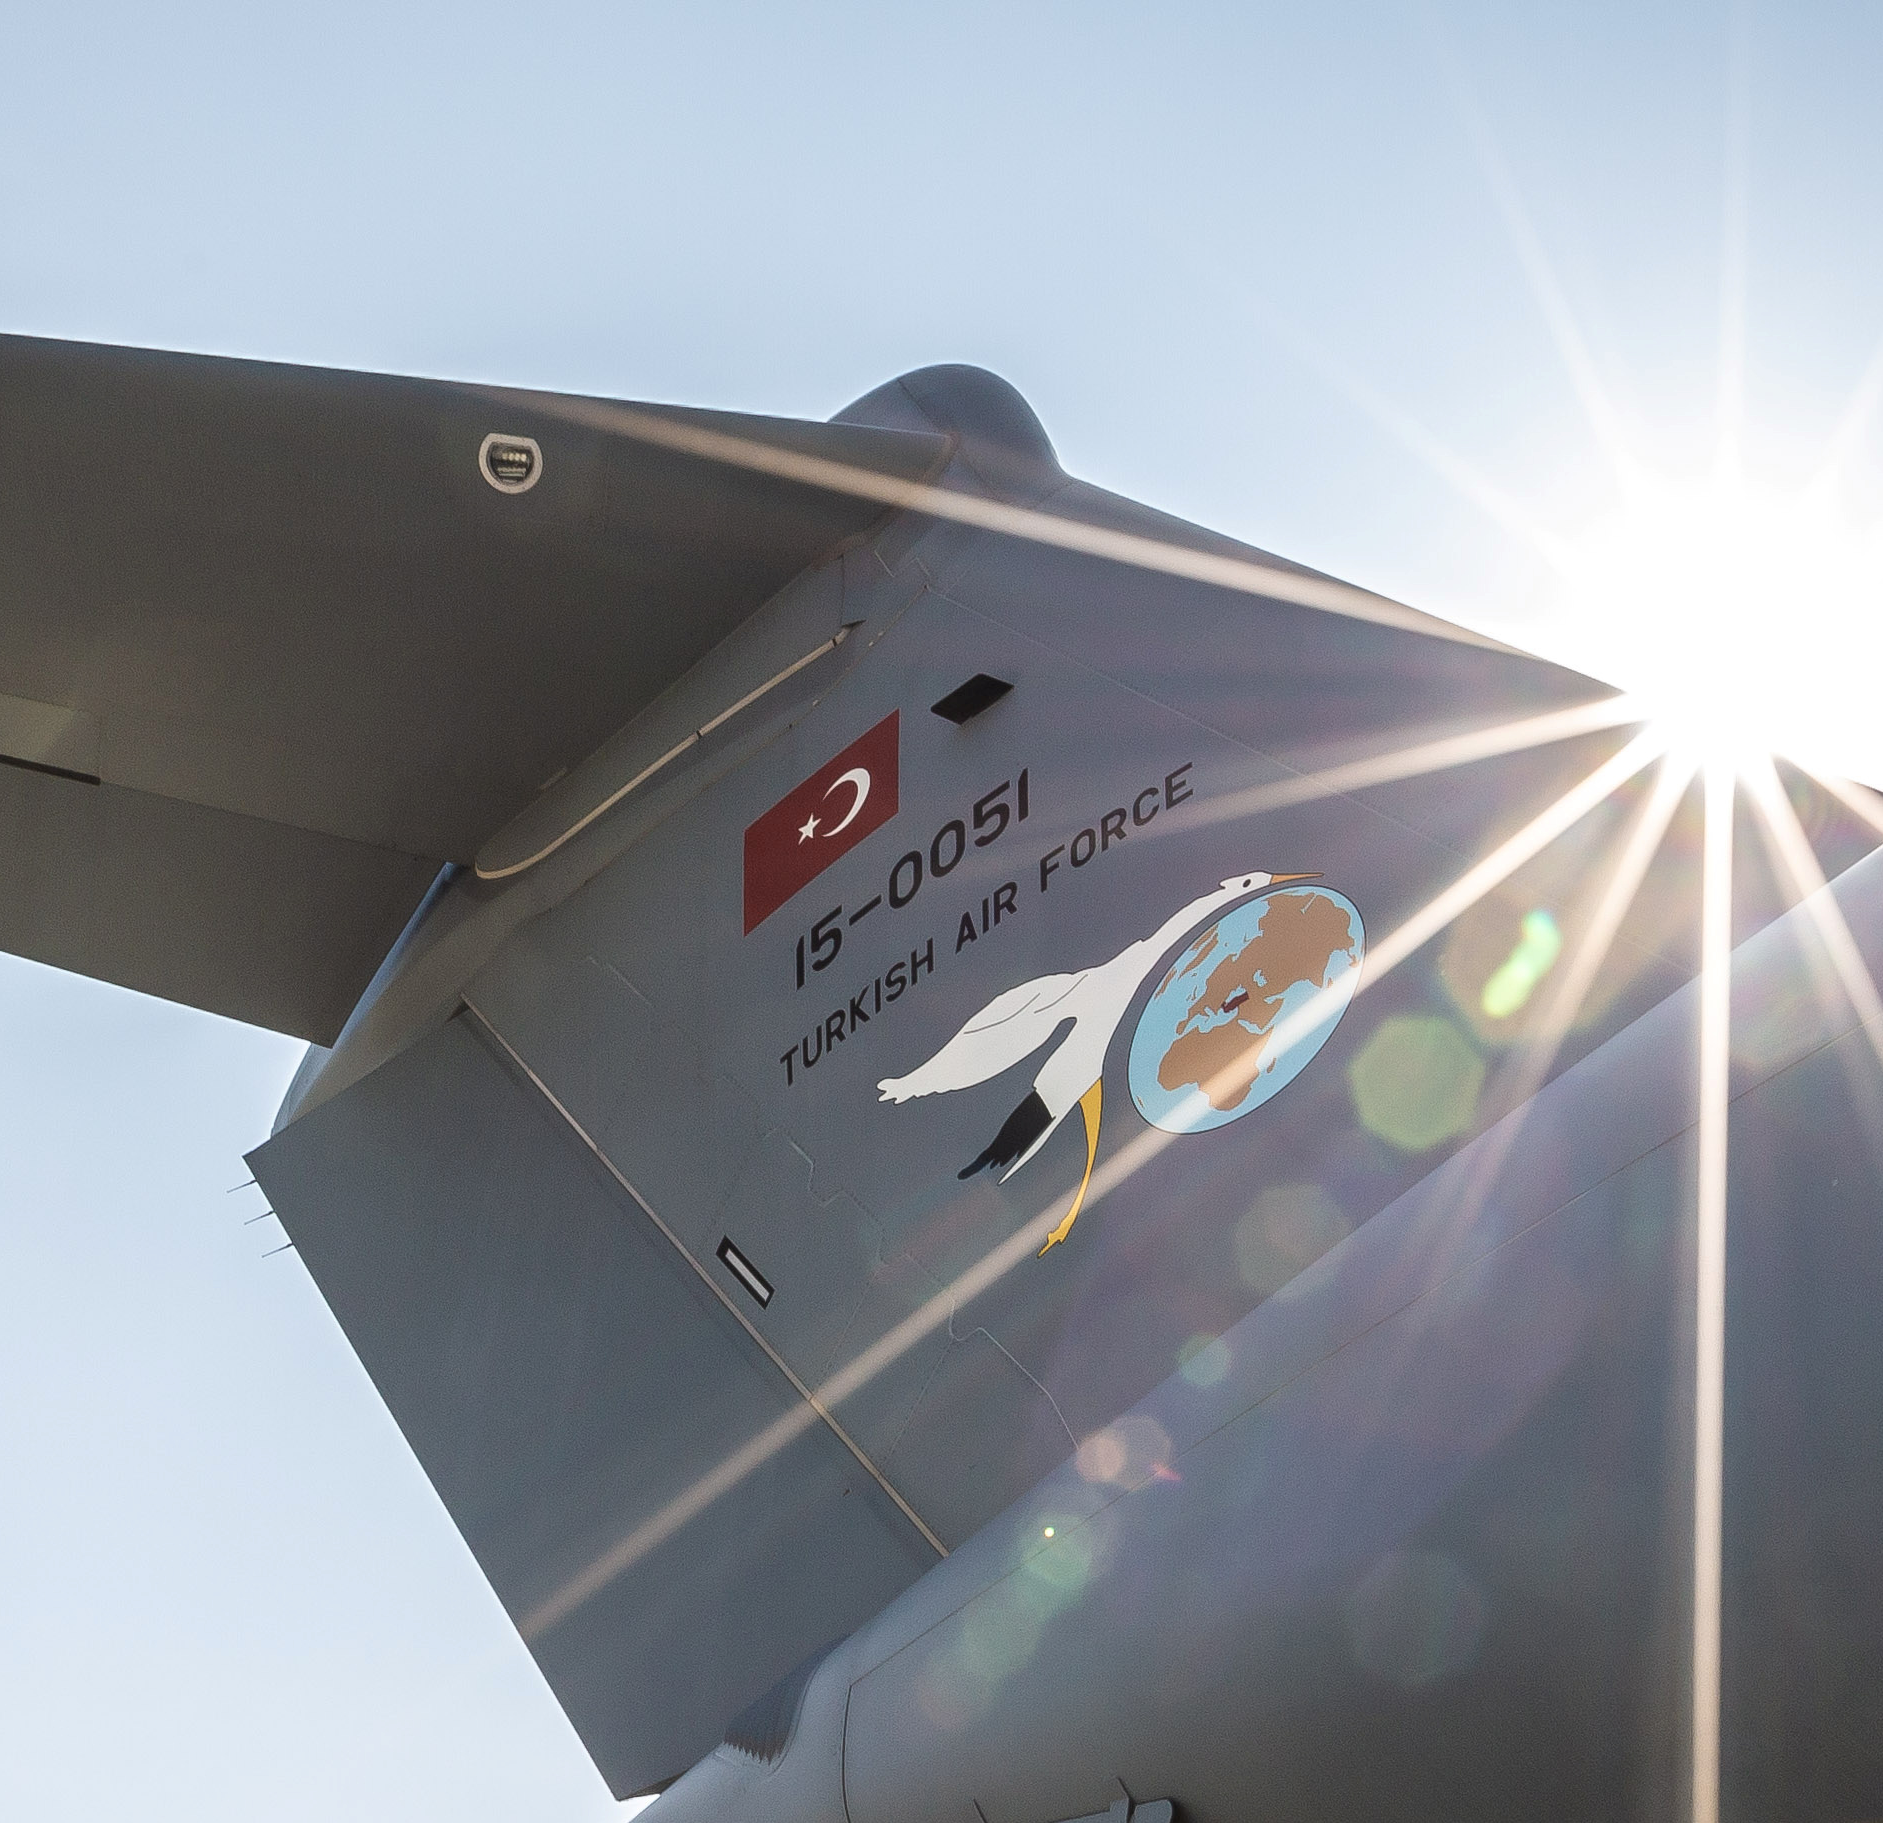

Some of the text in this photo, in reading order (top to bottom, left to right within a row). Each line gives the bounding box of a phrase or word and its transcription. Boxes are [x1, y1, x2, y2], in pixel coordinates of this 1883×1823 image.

[779, 762, 1196, 1087] TURKISH AIR FORCE
[794, 767, 1031, 990] 15-0051
